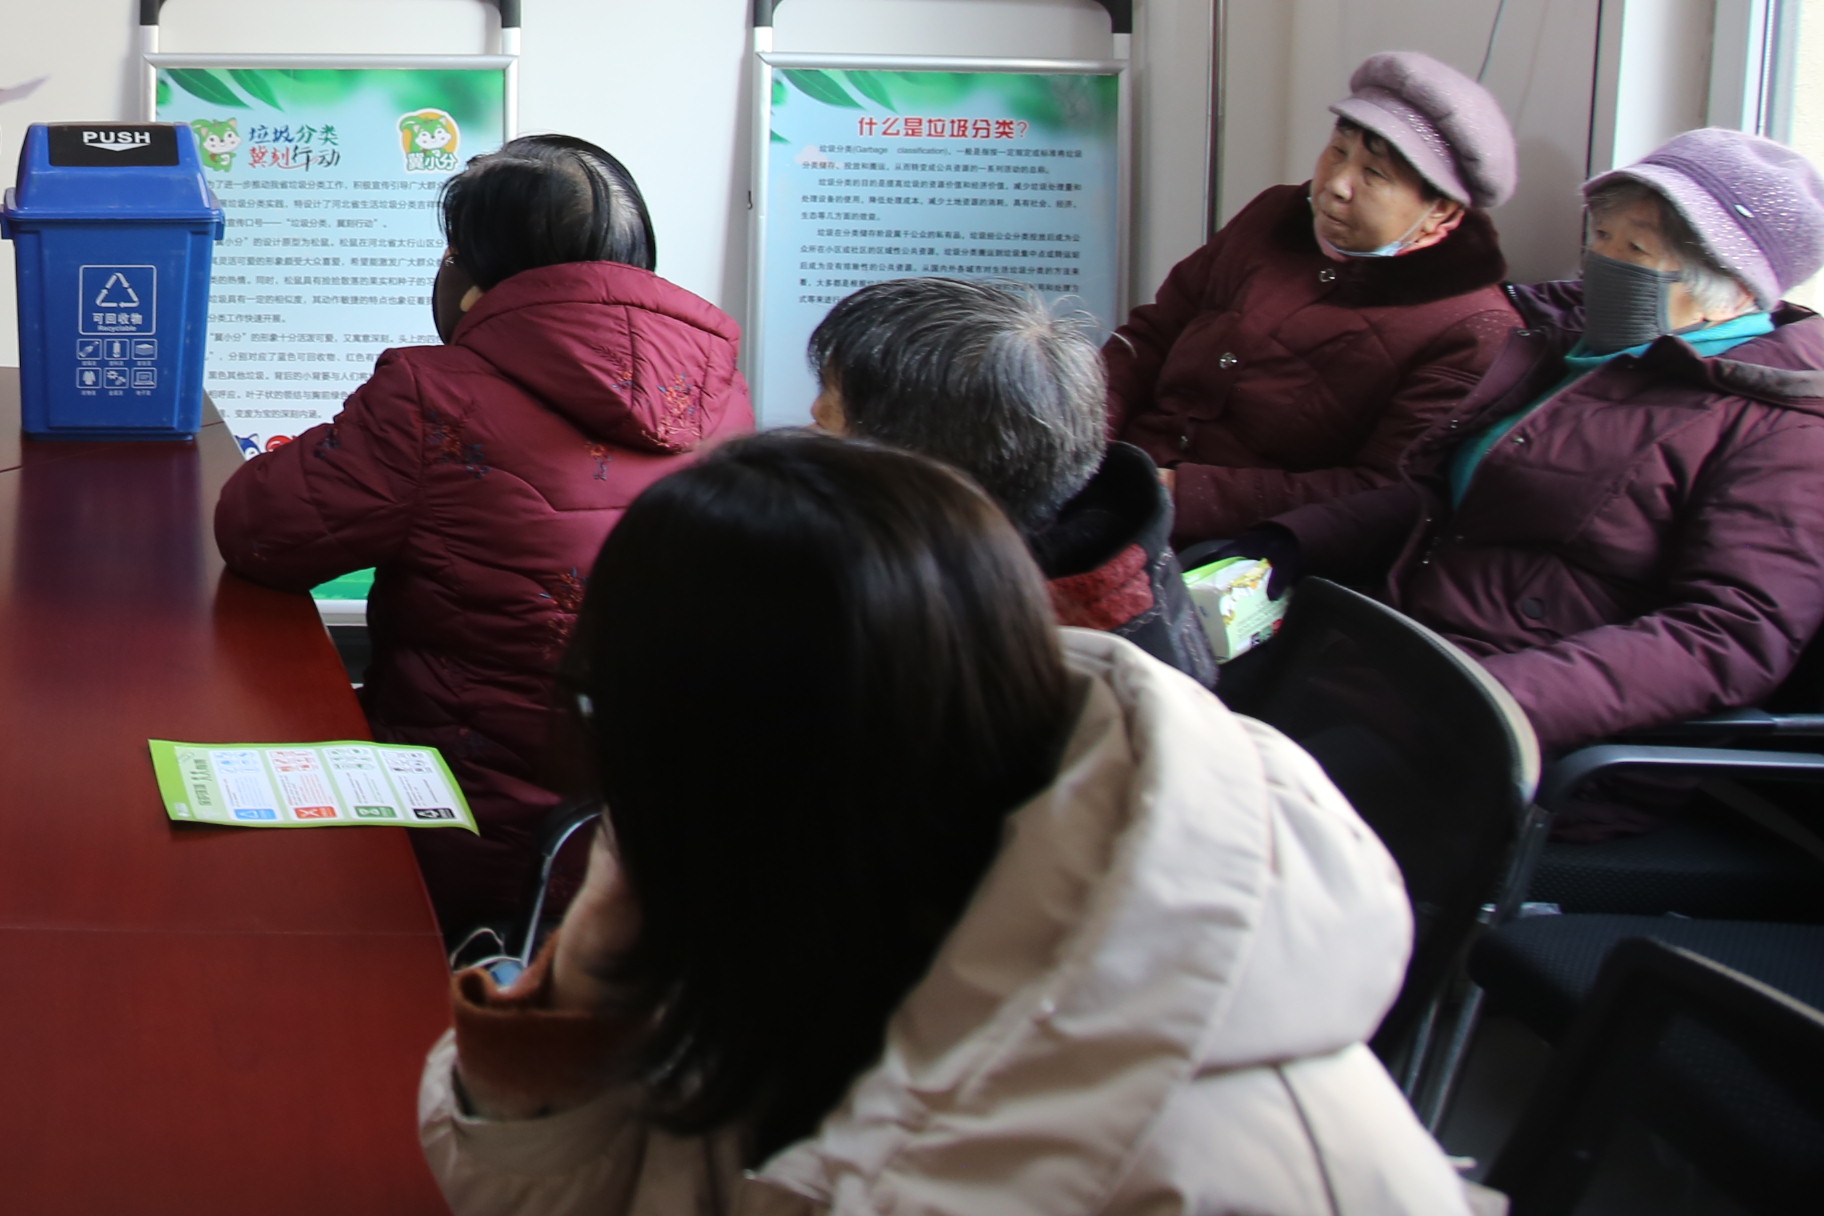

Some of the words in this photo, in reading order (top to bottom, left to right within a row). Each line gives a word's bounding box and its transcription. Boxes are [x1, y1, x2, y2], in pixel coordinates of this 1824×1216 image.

[82, 130, 152, 145] PUSH
[248, 124, 340, 146] 垃圾分类
[858, 116, 1031, 140] 什么是垃圾分类？
[247, 145, 342, 173] 冀刻行动
[407, 150, 458, 172] 冀小分
[92, 312, 143, 325] 可回收物
